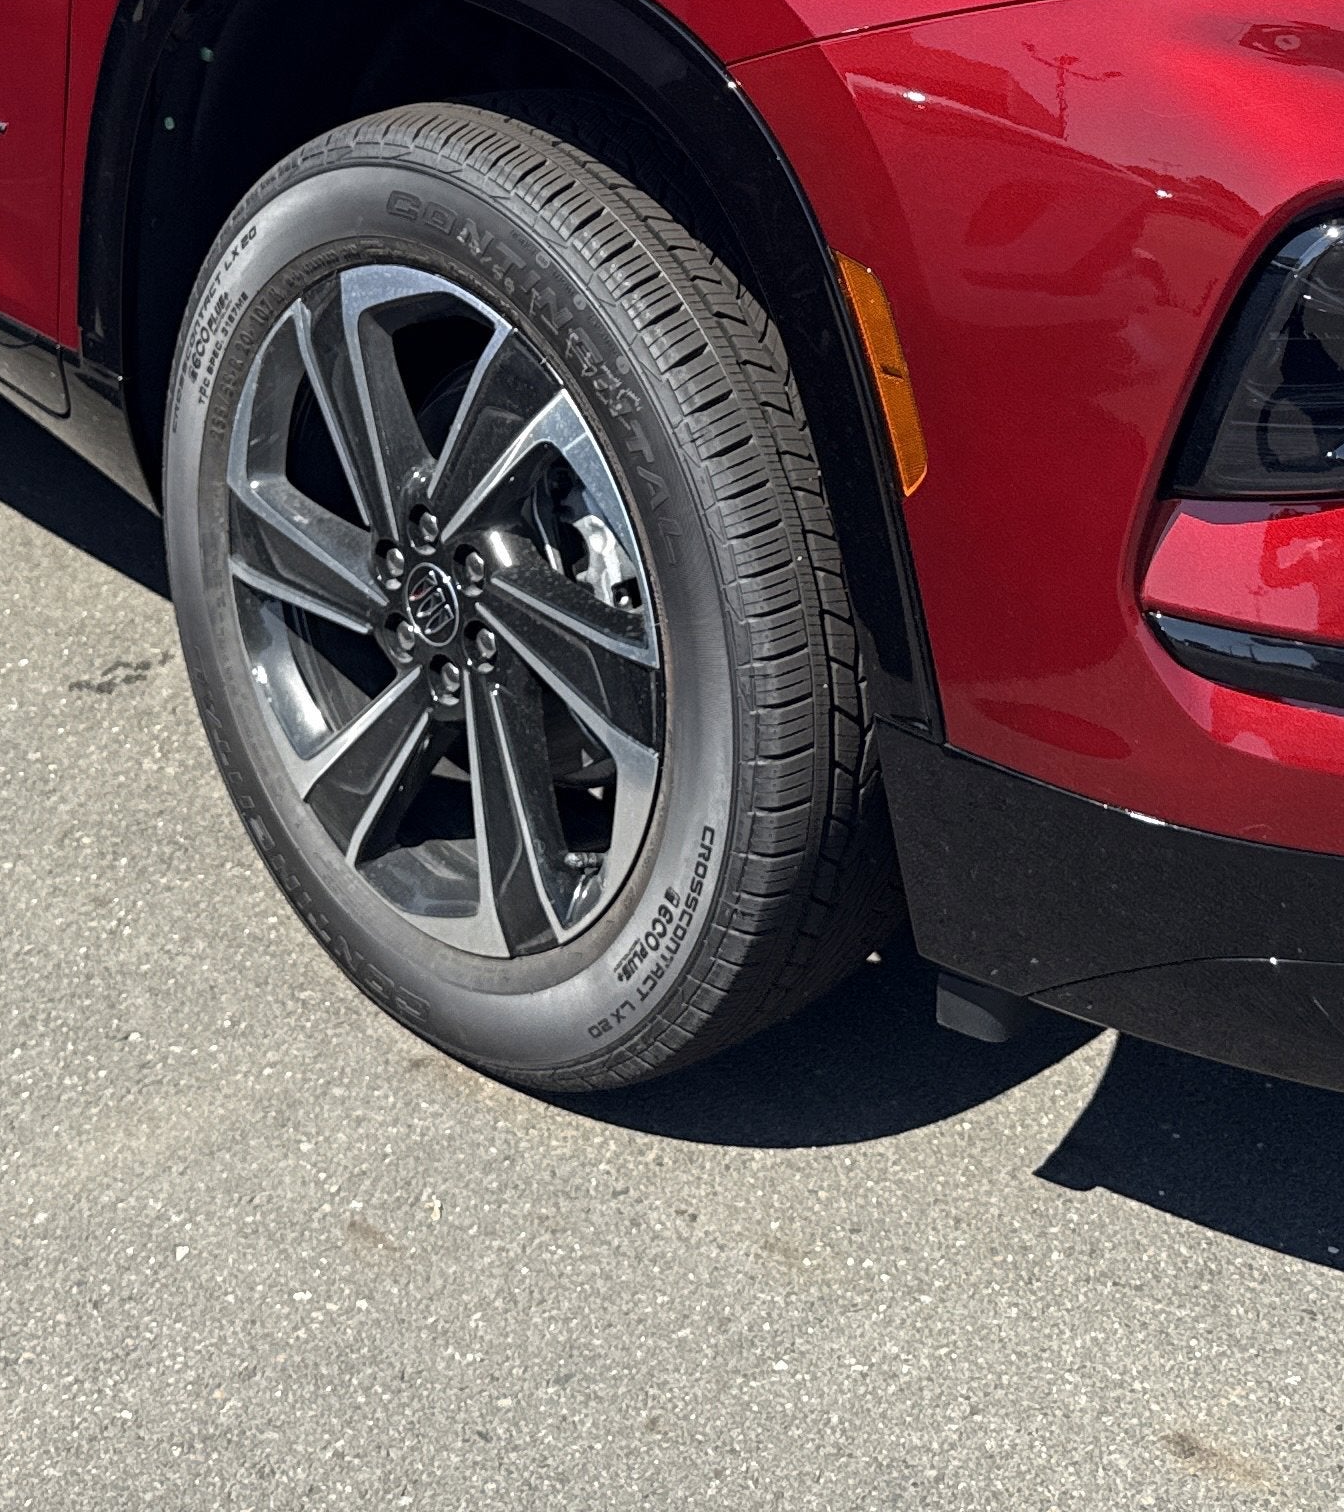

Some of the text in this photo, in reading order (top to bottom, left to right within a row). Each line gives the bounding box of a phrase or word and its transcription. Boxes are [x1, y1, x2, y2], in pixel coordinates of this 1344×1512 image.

[636, 824, 716, 1003] CROSSCONTACT
[615, 999, 638, 1024] LX
[587, 1020, 614, 1040] 20
